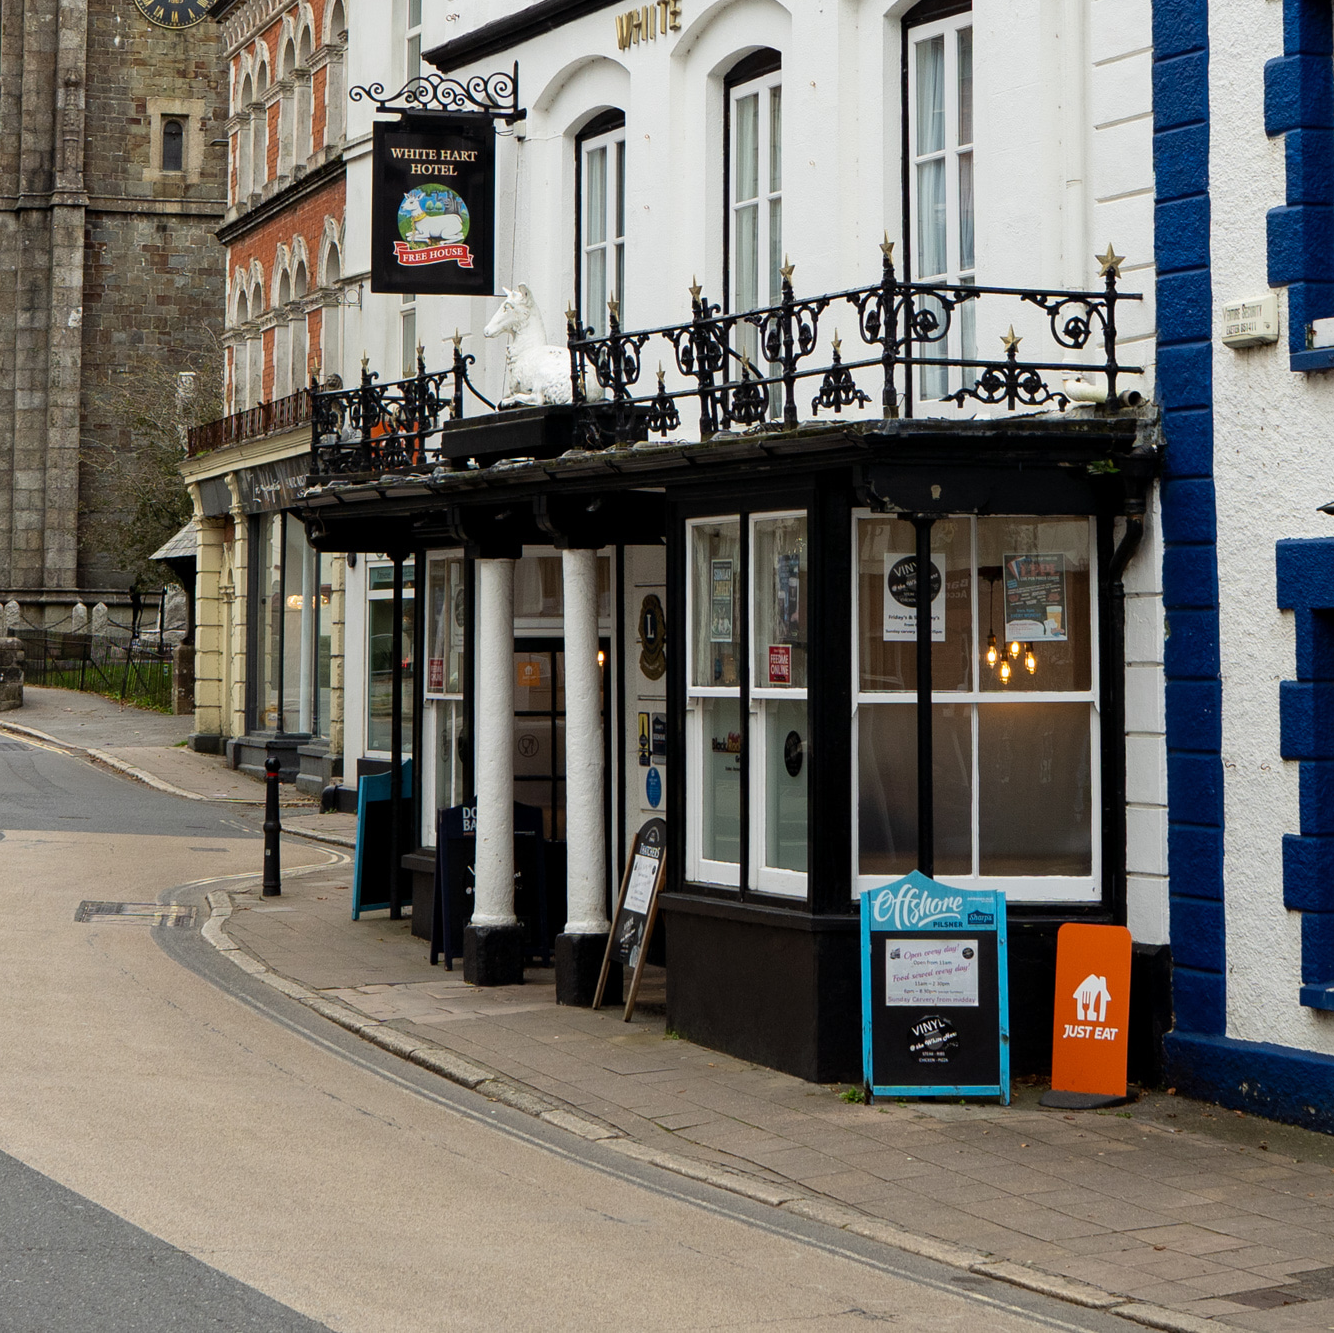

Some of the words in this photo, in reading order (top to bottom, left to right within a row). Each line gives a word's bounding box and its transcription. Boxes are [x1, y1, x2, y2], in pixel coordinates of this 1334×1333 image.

[390, 147, 437, 160] WHITE
[440, 149, 478, 162] HART
[410, 164, 458, 176] HOTEL
[402, 252, 427, 262] FREE
[430, 247, 464, 259] HOUSE
[893, 562, 917, 577] VIN
[647, 614, 655, 639] L
[462, 806, 477, 819] DO
[463, 819, 477, 832] BA
[871, 883, 964, 930] Offshore
[903, 950, 922, 961] Open
[924, 948, 942, 957] every
[893, 973, 910, 983] Food
[912, 970, 934, 979] served
[935, 968, 953, 976] every
[911, 1018, 945, 1036] VINYL
[1062, 1024, 1093, 1039] JUST
[1094, 1027, 1119, 1041] EAT
[916, 1042, 925, 1050] the
